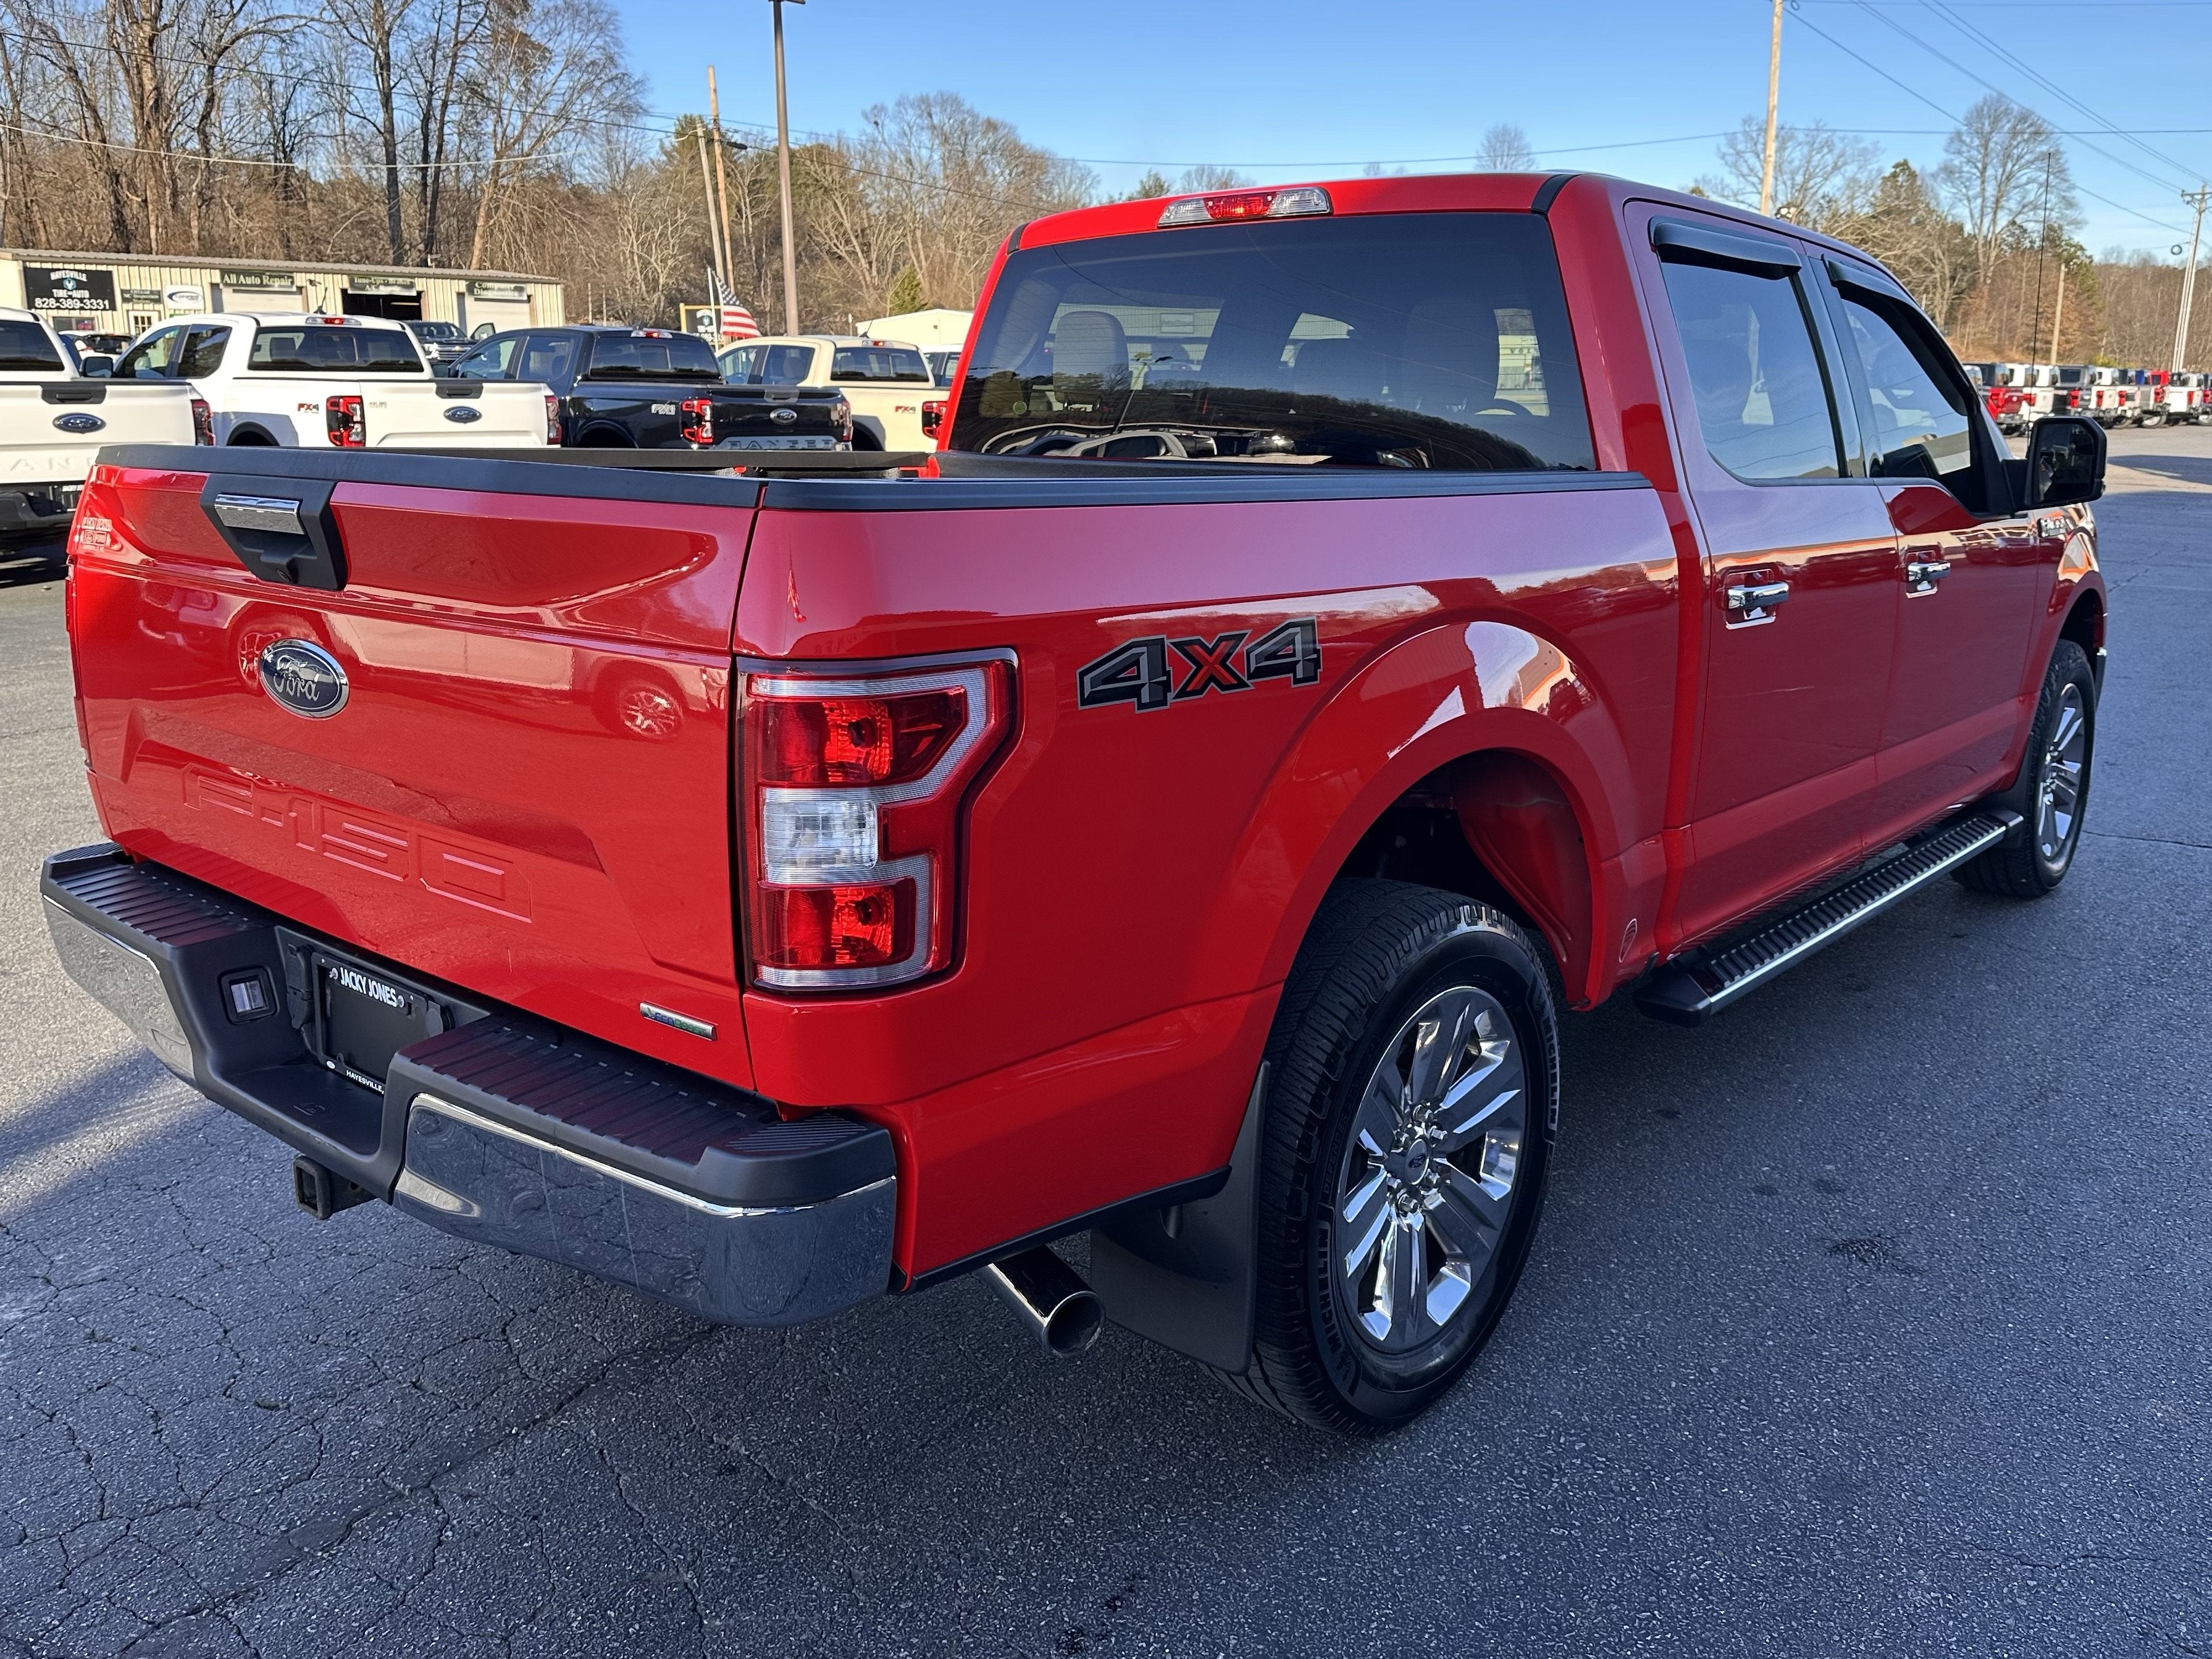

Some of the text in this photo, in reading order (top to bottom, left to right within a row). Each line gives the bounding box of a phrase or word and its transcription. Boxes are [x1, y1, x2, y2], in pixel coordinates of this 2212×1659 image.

[223, 274, 292, 287] All Auto Repair
[35, 298, 109, 309] 828-389-3331
[298, 403, 319, 411] FX4
[182, 762, 532, 923] F-150
[340, 967, 397, 1007] JACKY JONES
[346, 1070, 384, 1094] HAYESVILLE,
[1318, 1228, 1342, 1354] MICHELIN
